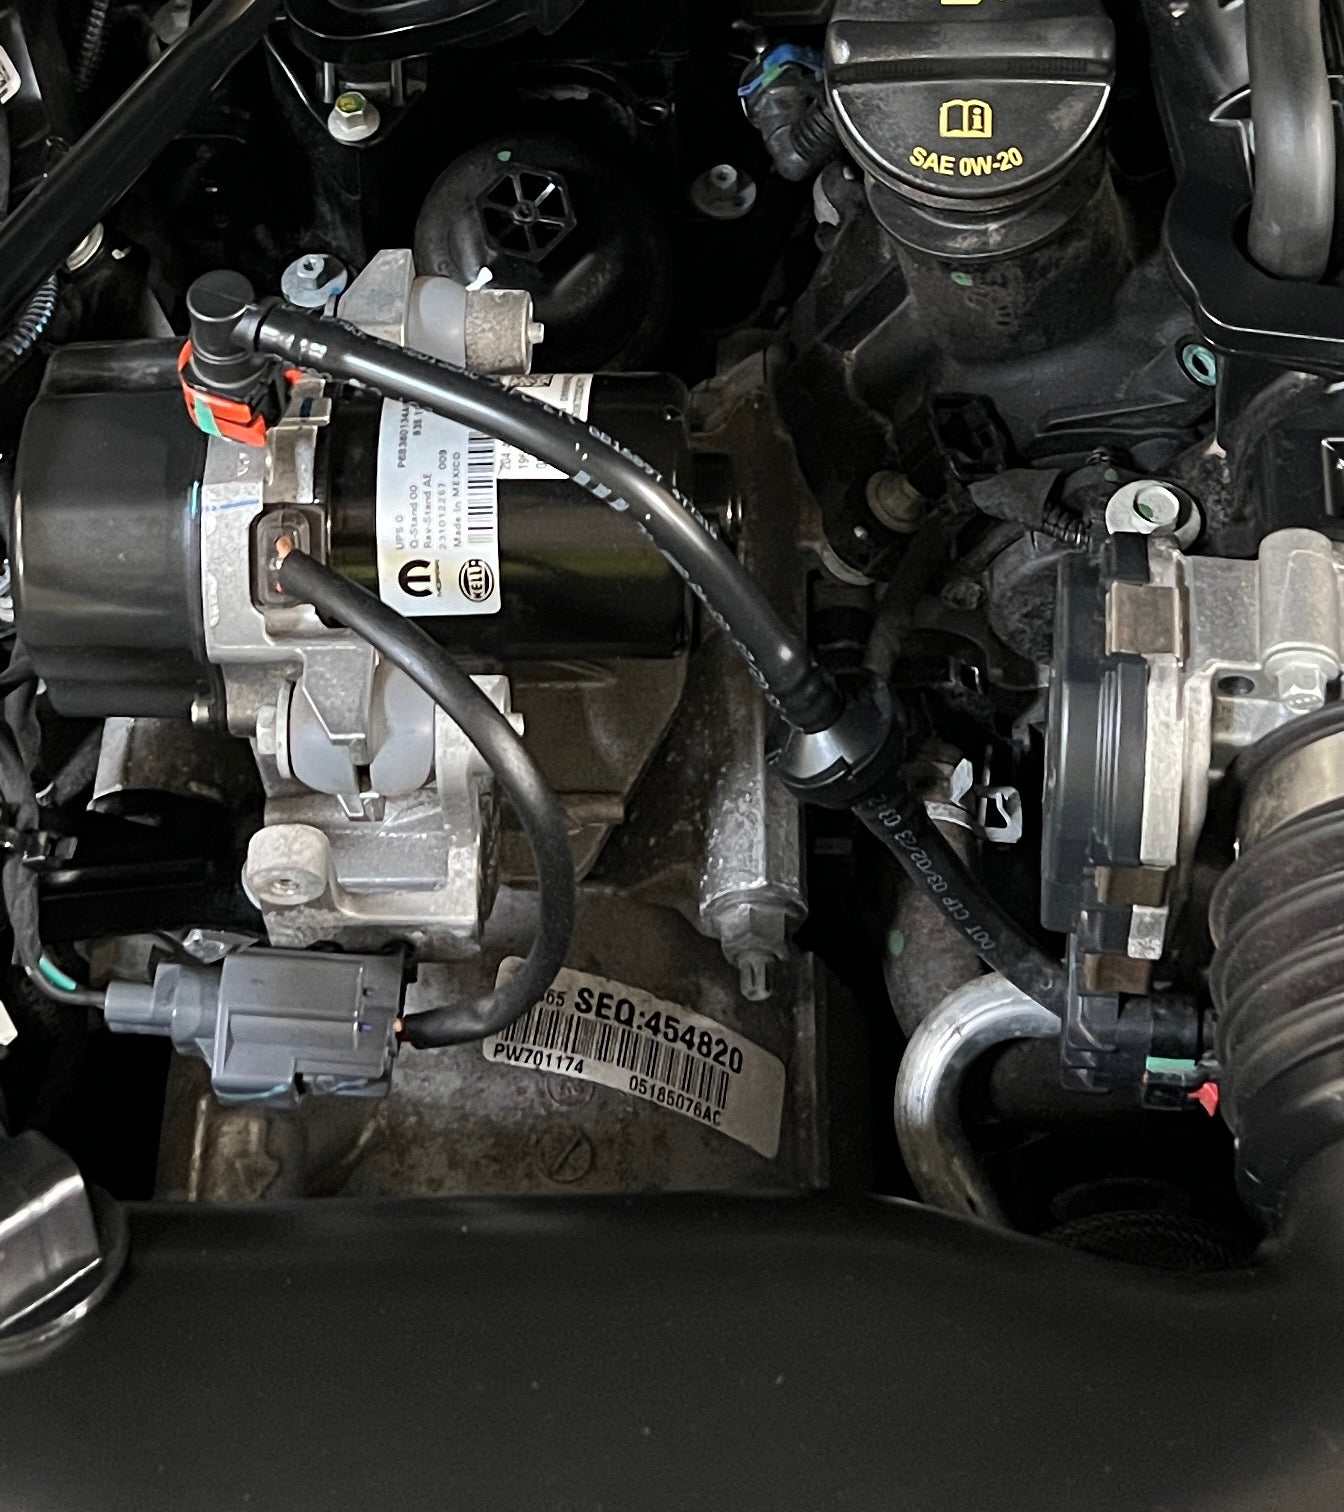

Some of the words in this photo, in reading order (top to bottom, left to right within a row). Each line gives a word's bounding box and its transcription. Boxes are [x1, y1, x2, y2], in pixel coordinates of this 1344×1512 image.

[909, 146, 956, 176] SAE
[959, 147, 1023, 177] 0W-20
[452, 451, 461, 497] MEXICO
[453, 516, 462, 548] Made
[468, 558, 483, 599] HELLA
[574, 987, 743, 1075] SEQ:454820
[493, 1042, 584, 1074] PW701174
[629, 1075, 721, 1127] 05185076AC
